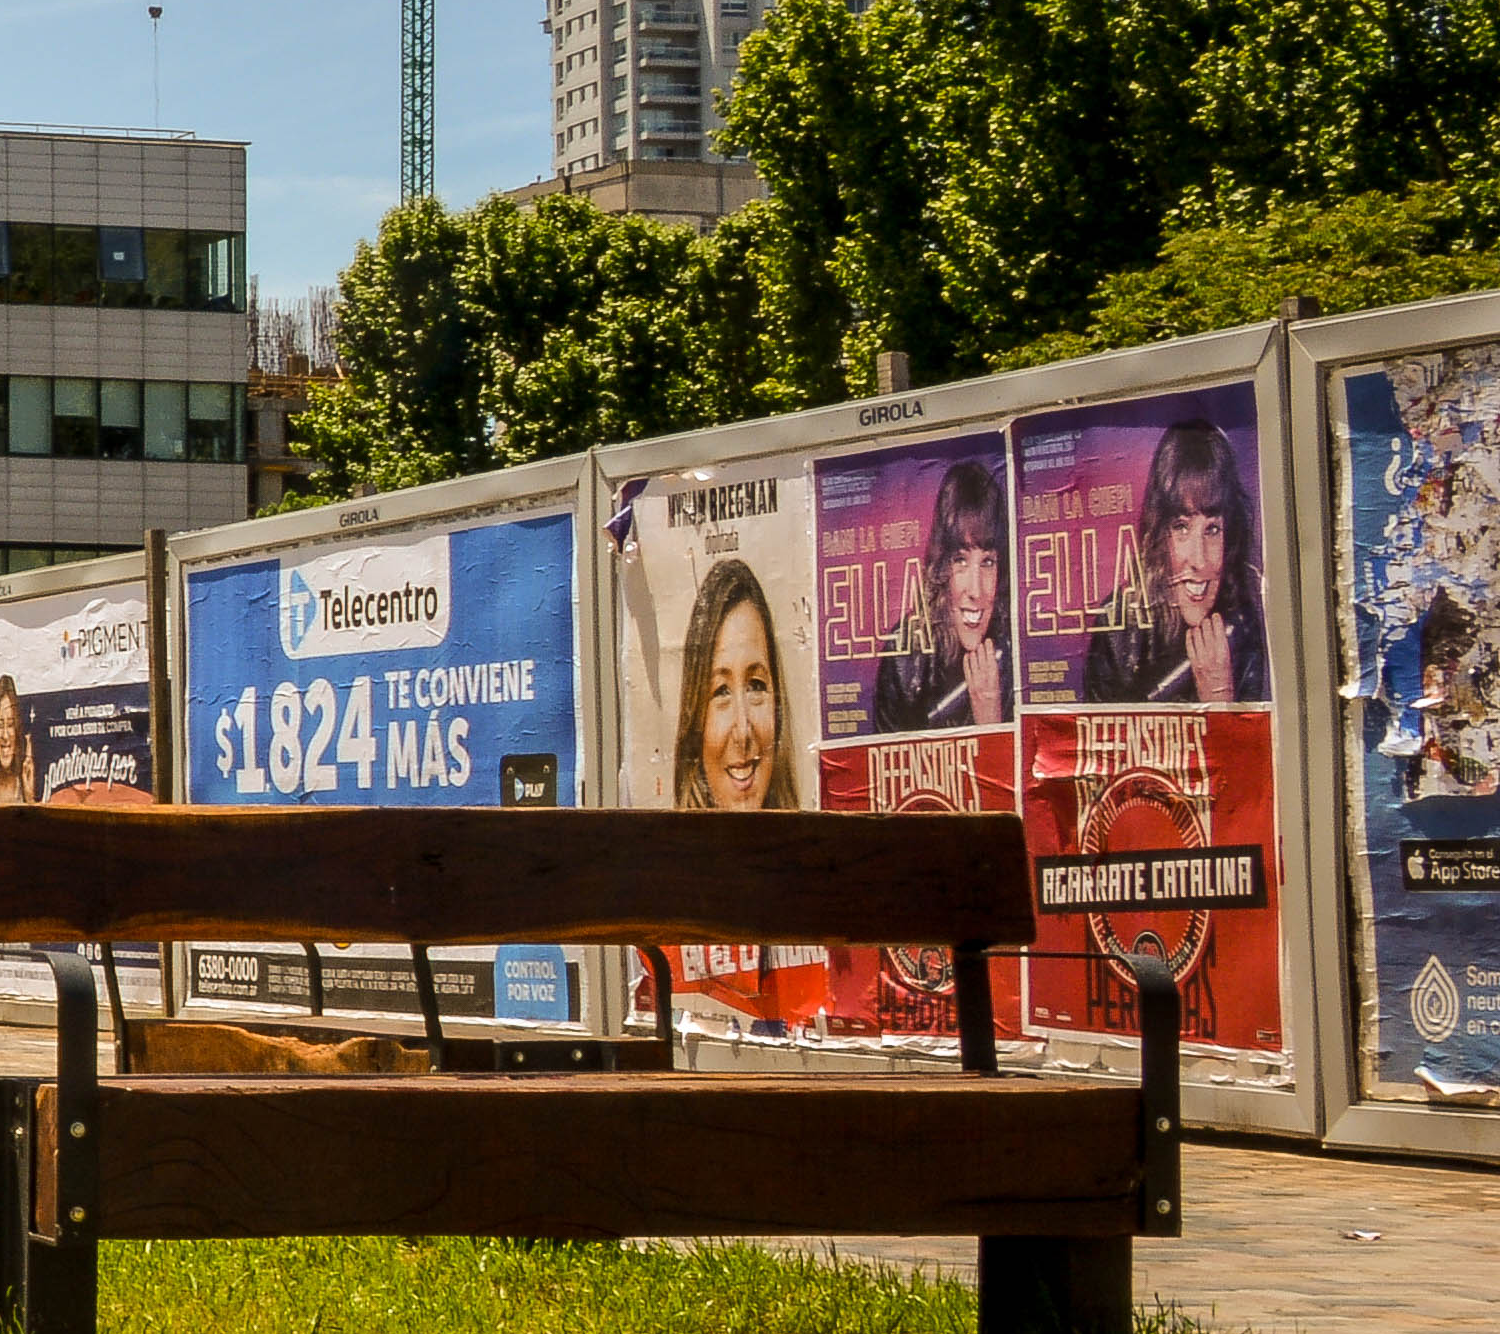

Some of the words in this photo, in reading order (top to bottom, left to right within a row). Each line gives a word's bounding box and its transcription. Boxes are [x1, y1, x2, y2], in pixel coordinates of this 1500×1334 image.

[859, 401, 924, 427] GIROLA
[339, 509, 380, 528] GIROLA
[709, 478, 778, 523] BREGMAN
[1025, 524, 1155, 637] ELLA
[320, 580, 438, 631] Telecentro
[823, 557, 935, 661] ELLA
[385, 668, 412, 710] TE
[414, 660, 536, 707] CONVIENE
[386, 710, 471, 790] MÁS
[1042, 861, 1147, 905] AGARRATE
[1150, 856, 1253, 900] CATALINA
[1430, 860, 1460, 884] App
[1462, 860, 1500, 881] Store
[198, 954, 259, 982] 6380-0000
[504, 960, 557, 980] CONTROL
[1086, 915, 1217, 1038] PERAS
[507, 983, 528, 1002] POR
[531, 983, 556, 1003] VOZ
[1467, 1019, 1487, 1036] en
